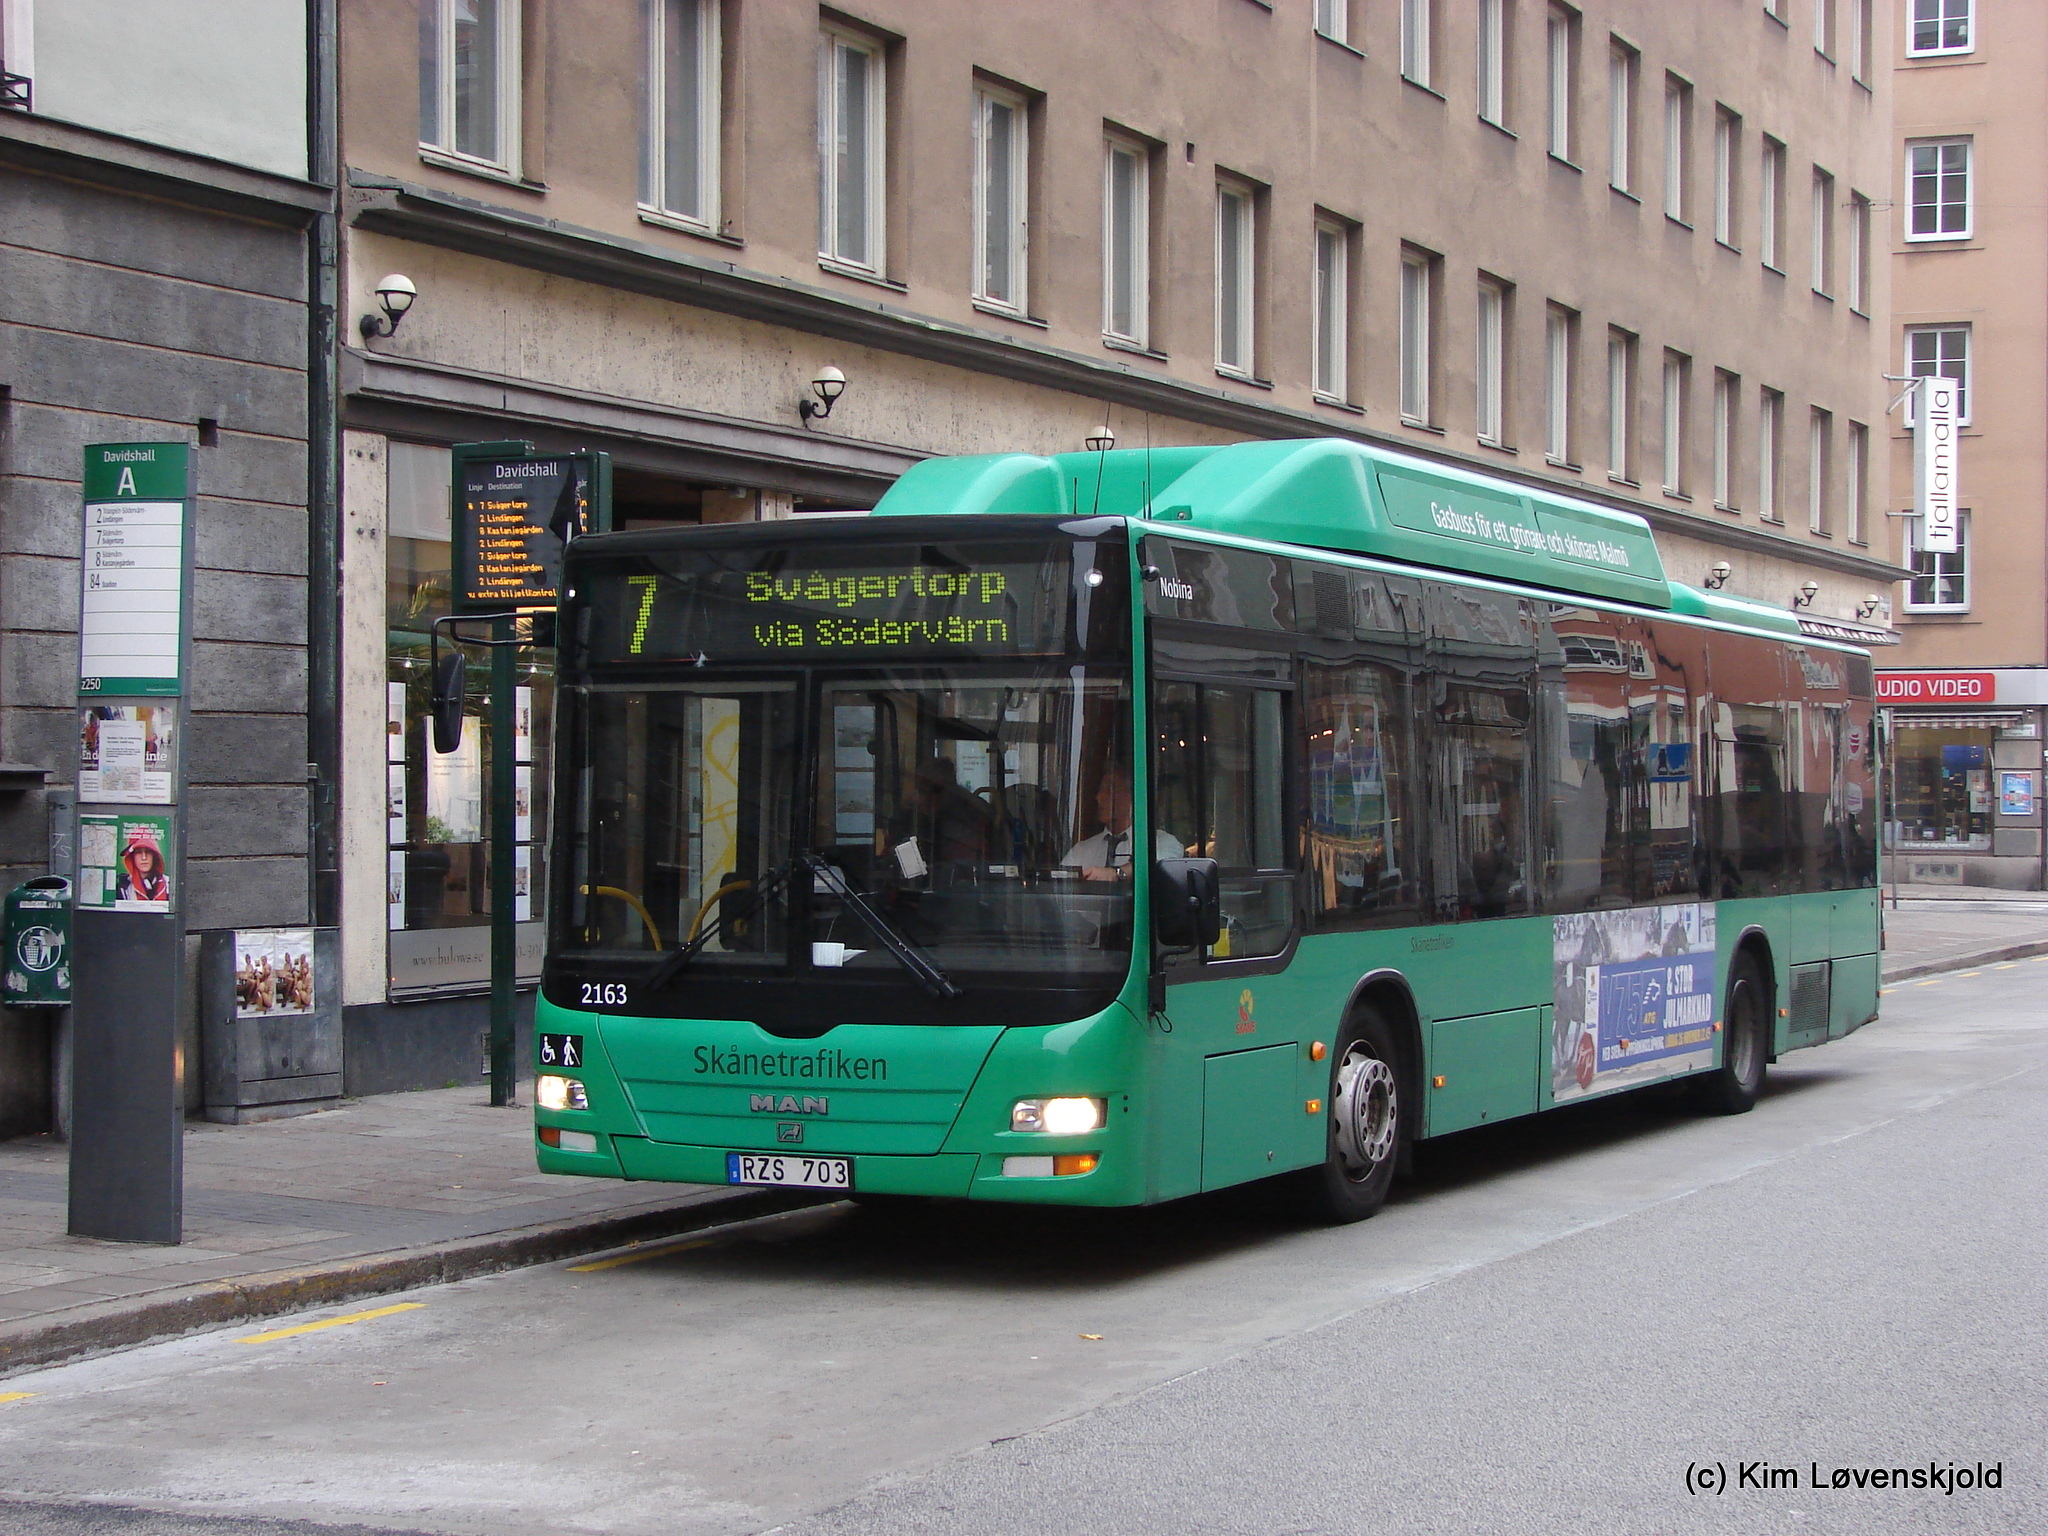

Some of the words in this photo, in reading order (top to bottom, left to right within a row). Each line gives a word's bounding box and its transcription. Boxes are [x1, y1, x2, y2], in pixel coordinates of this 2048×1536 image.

[104, 449, 156, 463] Davidshall
[495, 462, 558, 478] Davidshall
[1929, 390, 1953, 539] tjallamalla
[117, 466, 137, 496] A
[468, 483, 484, 492] Linje
[488, 482, 523, 491] Destination
[479, 502, 485, 510] 7
[96, 508, 102, 523] 2
[96, 530, 102, 545] 7
[479, 527, 485, 535] 8
[1430, 501, 1476, 536] Gasbuss
[1475, 511, 1492, 538] för
[1493, 522, 1510, 543] ett
[1510, 522, 1546, 550] grönare
[1547, 531, 1564, 554] och
[1564, 532, 1600, 561] skönare
[1599, 540, 1629, 567] Malmö
[479, 539, 485, 547] 2
[95, 551, 101, 567] 8
[479, 552, 484, 560] 7
[479, 565, 484, 573] 8
[90, 573, 100, 589] 84
[478, 577, 485, 585] 2
[1160, 577, 1193, 600] Nobina
[629, 575, 657, 654] 7
[746, 566, 1006, 608] Svågertorp
[754, 620, 804, 648] via
[816, 615, 1008, 646] Södervärn
[81, 678, 101, 690] z250
[1926, 679, 1982, 697] VIDEO
[146, 751, 168, 761] inte
[1674, 963, 1693, 995] STOR
[581, 983, 628, 1005] 2163
[1663, 992, 1712, 1029] JULMARKNAD
[692, 1044, 888, 1081] Skånetrafiken
[750, 1094, 828, 1115] MAN
[743, 1157, 785, 1181] RZS
[802, 1159, 847, 1184] 703
